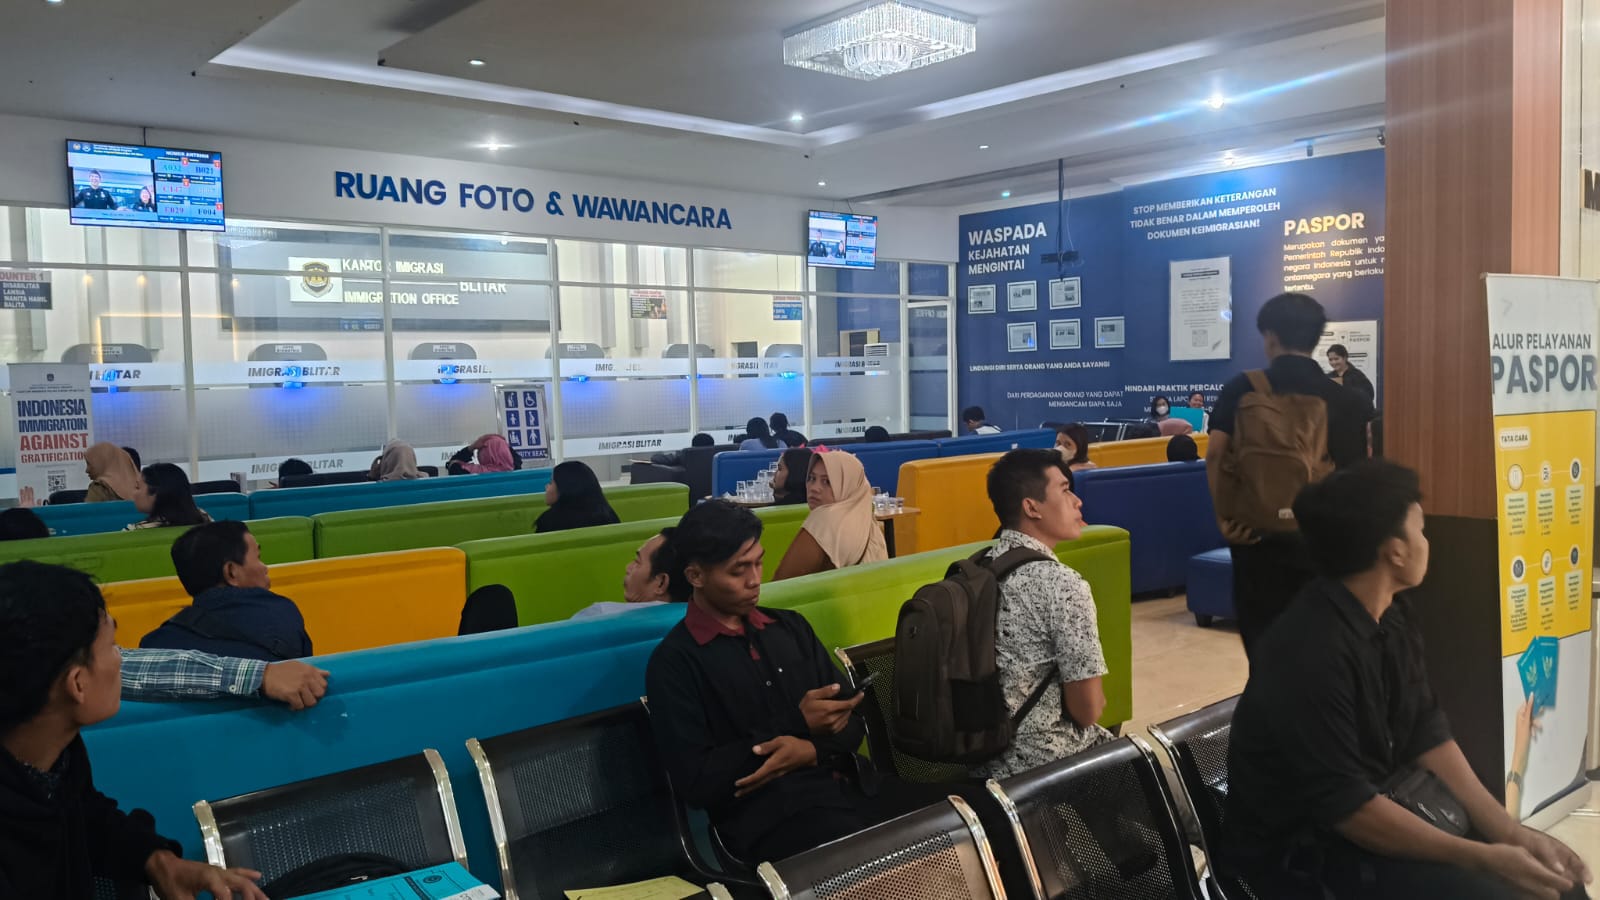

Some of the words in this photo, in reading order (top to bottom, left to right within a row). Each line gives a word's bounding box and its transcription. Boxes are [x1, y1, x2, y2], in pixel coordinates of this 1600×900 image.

[335, 171, 447, 206] RUANG
[459, 182, 534, 213] FOTO
[545, 191, 565, 216] &
[572, 193, 732, 230] WAWANCARA
[1133, 204, 1156, 214] STOP
[1156, 197, 1213, 212] MEMBERIKAN
[1214, 188, 1277, 204] KETERANGAN
[1130, 218, 1156, 229] TIDAK
[1156, 215, 1184, 226] BENAR
[1186, 212, 1217, 222] DALAM
[1218, 202, 1280, 218] MEMPEROLEH
[1148, 228, 1190, 240] DOKUMEN
[1192, 219, 1260, 234] KEIMIGRASIAN!
[1284, 212, 1365, 236] PASPOR
[968, 221, 1048, 246] WASPADA
[1283, 241, 1325, 252] Merupakan
[1331, 237, 1368, 246] dokumen
[968, 243, 1030, 262] KEJAHATAN
[1283, 251, 1326, 261] Pemerintah
[1330, 248, 1363, 258] Republik
[396, 260, 444, 274] IMIGRASI
[968, 258, 1025, 276] MENGINTAI
[1284, 264, 1310, 272] negara
[1314, 259, 1351, 269] Indonesia
[1354, 257, 1377, 266] untuk
[1332, 270, 1352, 280] yang
[1354, 268, 1384, 276] berlaku
[344, 291, 418, 304] IMMIGRTION
[422, 293, 460, 305] OFFICE
[1492, 333, 1524, 350] ALUR
[1526, 333, 1592, 350] PELAYANAN
[1082, 360, 1110, 368] SAYANGI
[1491, 354, 1598, 395] PASPOR
[1104, 390, 1124, 398] DAPAT
[1124, 384, 1156, 392] HINDARI
[1156, 384, 1188, 392] PRAKTIK
[17, 398, 88, 418] INDONESIA
[1048, 400, 1088, 408] MENGANCAM
[1106, 400, 1122, 408] SAJA
[18, 418, 88, 433] IMMIGRATOIN
[20, 432, 89, 452] AGAINST
[1500, 434, 1513, 443] TATA
[21, 452, 86, 464] GRATIFICATIO
